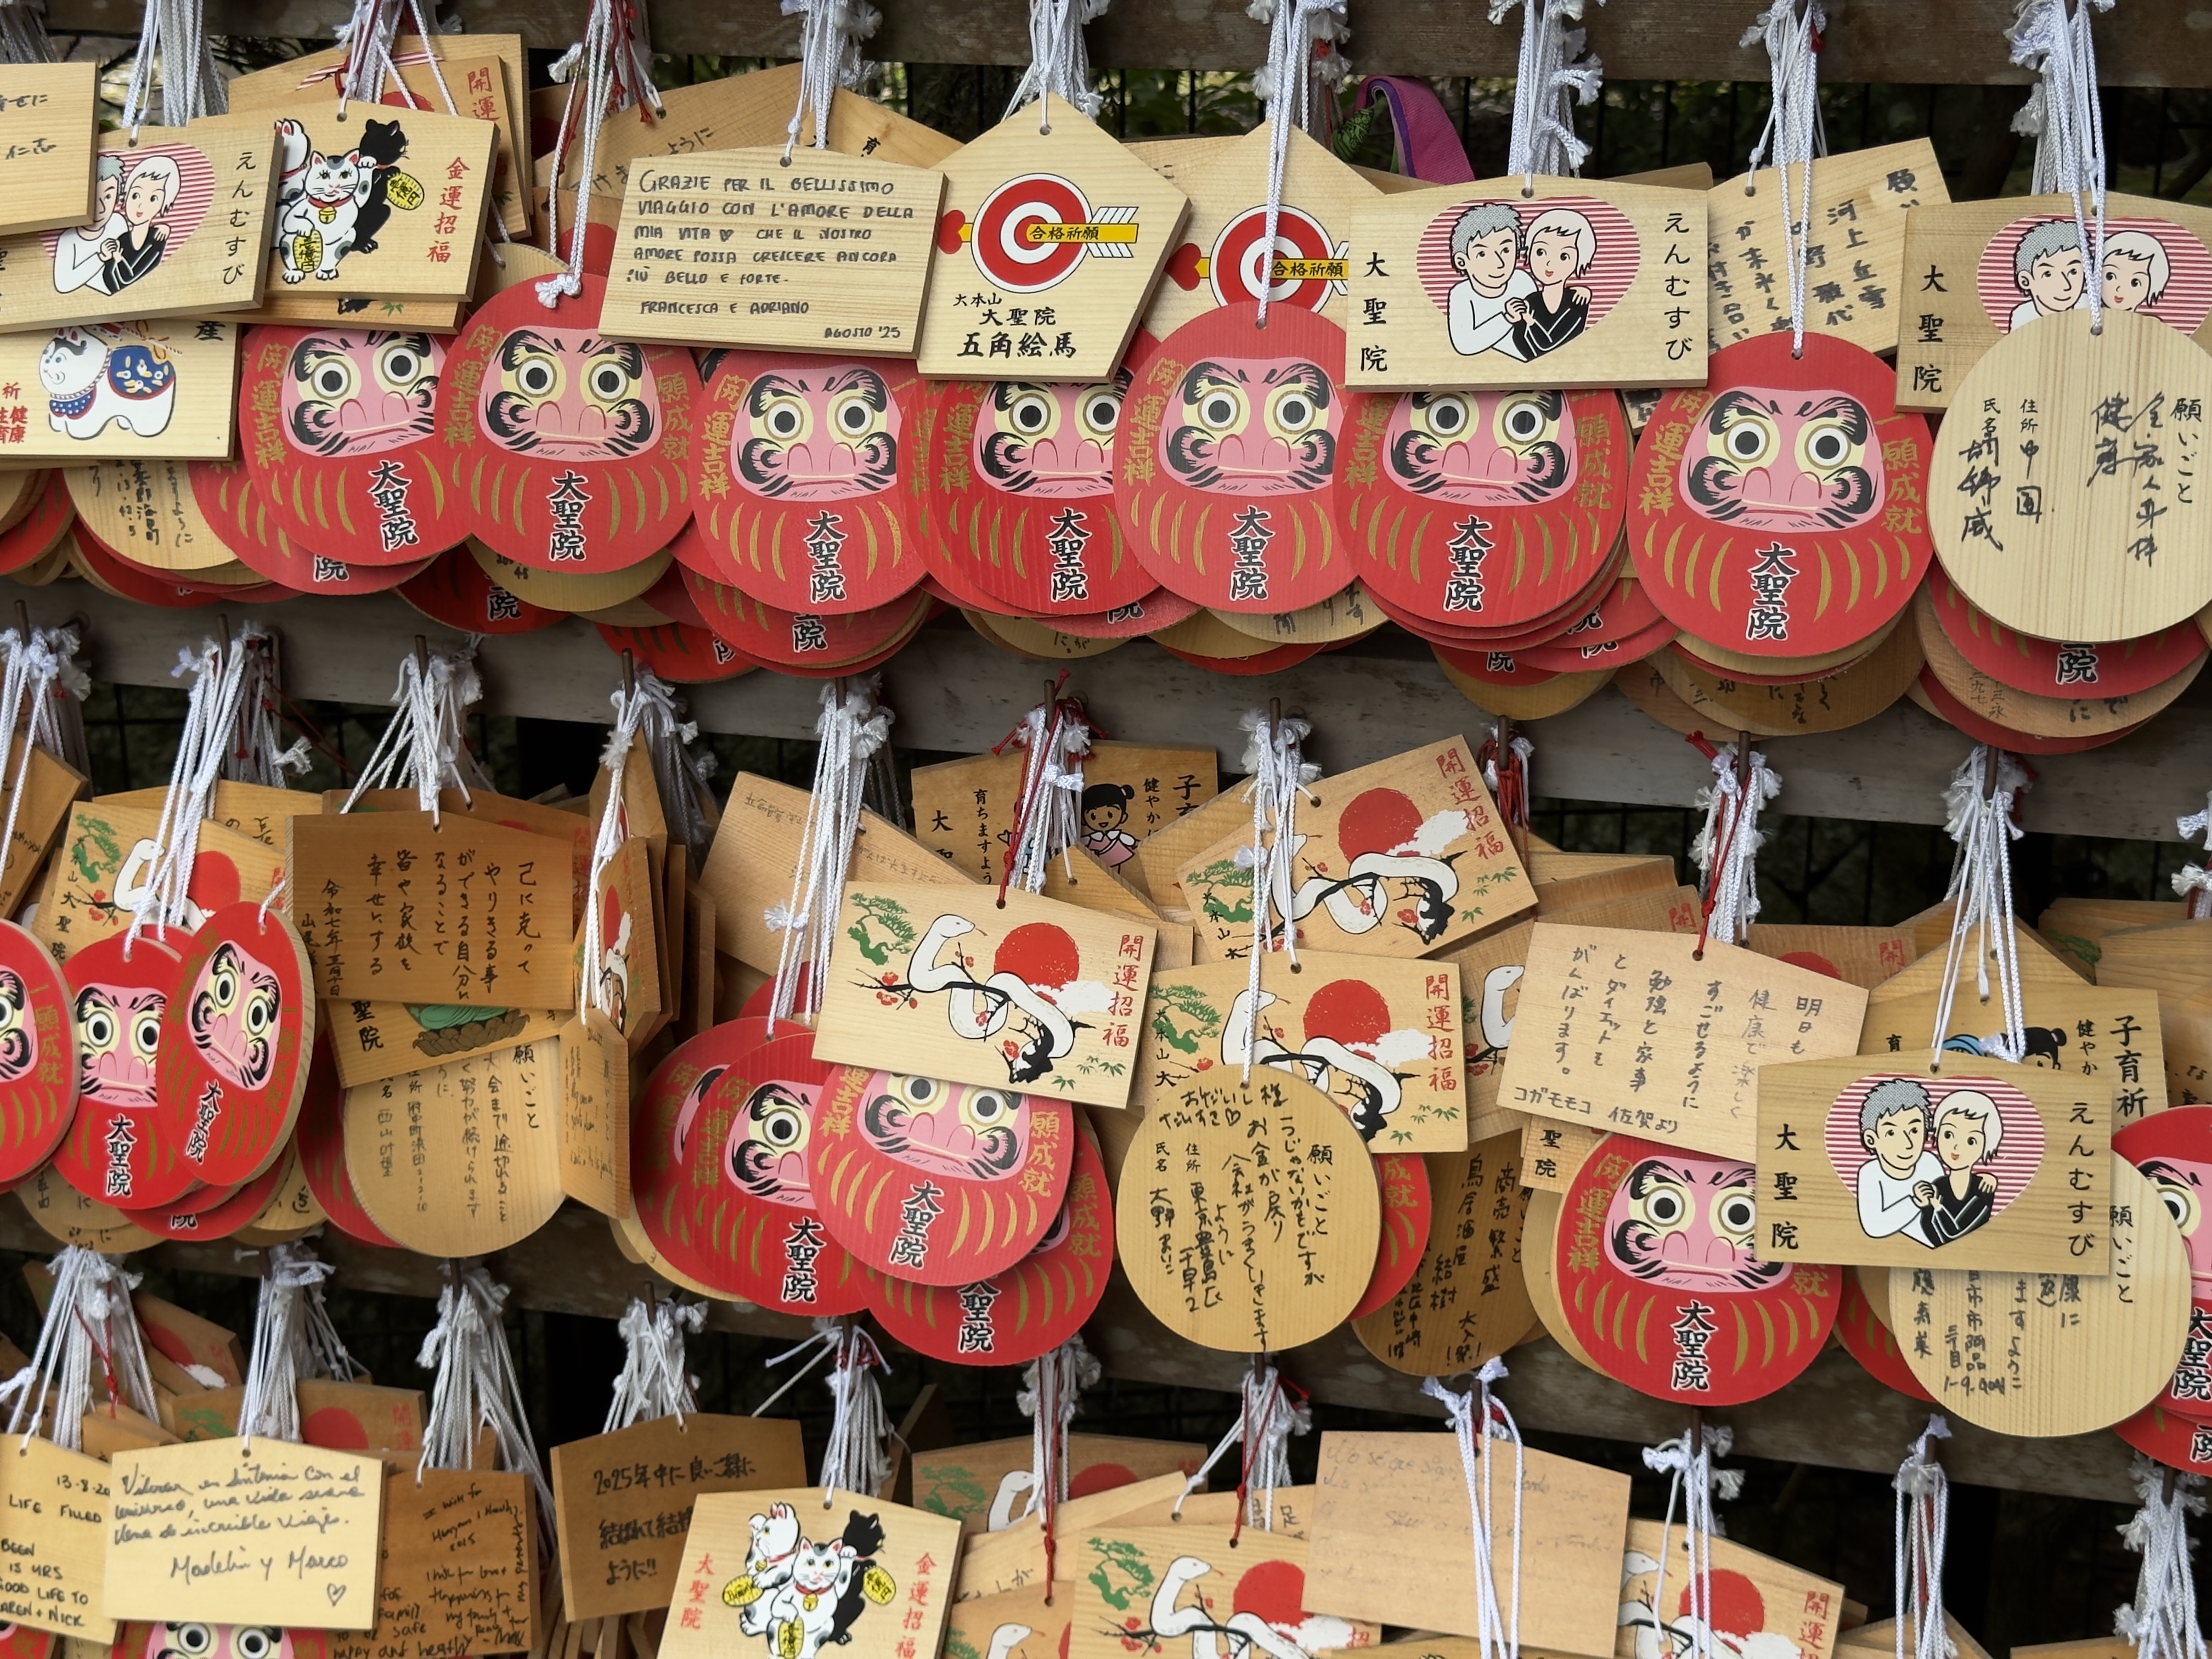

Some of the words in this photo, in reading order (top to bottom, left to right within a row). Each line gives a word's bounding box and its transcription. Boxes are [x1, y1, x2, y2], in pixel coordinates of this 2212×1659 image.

[223, 151, 256, 285] えんむすび
[427, 157, 470, 264] 金運招福
[640, 169, 712, 194] GRAZIE
[724, 178, 749, 193] PER
[760, 178, 775, 192] IL
[723, 202, 755, 216] CON
[863, 206, 914, 221] DELLA
[634, 247, 684, 262] AMORE
[753, 250, 826, 264] CRESCERE
[836, 250, 898, 263] ANCORA
[635, 225, 664, 241] MIA
[679, 226, 712, 241] VITA
[756, 228, 783, 241] CHE
[793, 228, 804, 241] IL
[665, 270, 709, 285] BELLO
[720, 272, 729, 285] E
[1029, 225, 1099, 241] 合格祈願
[1272, 260, 1344, 278] 合格祈願
[640, 300, 719, 317] FRANCESCA
[730, 301, 738, 315] E
[749, 300, 810, 315] ADRIANO
[953, 292, 1002, 307] 大本山
[979, 308, 1057, 327] 大聖院
[1360, 251, 1390, 373] 大聖院
[1663, 212, 1692, 360] えんむすび
[1912, 264, 1948, 393] 大聖院
[443, 323, 506, 449] 開運吉祥
[957, 332, 1077, 359] 五角絵馬
[252, 342, 292, 469] 開運吉祥
[698, 375, 753, 501] 開運吉祥
[1122, 357, 1187, 488] 開運吉祥
[1981, 398, 2001, 439] 氏名
[2020, 398, 2039, 434] 住所
[2170, 397, 2203, 504] 願いごと
[1638, 388, 1714, 517] 開運吉祥
[1874, 410, 1923, 535] 一願成就
[369, 461, 419, 551] 大聖院
[546, 470, 593, 562] 大聖院
[805, 511, 848, 603] 大聖院
[1046, 507, 1093, 604] 大聖院
[1227, 505, 1276, 602] 大聖院
[1445, 515, 1496, 613] 大聖院
[1745, 541, 1799, 641] 大聖院
[1436, 747, 1505, 860] 開運招福
[1102, 933, 1145, 1049] 開運招福
[1425, 973, 1459, 1092] 開運招福
[1790, 996, 1824, 1056] 明日も
[184, 1079, 224, 1165] 大聖院
[512, 1043, 540, 1130] 願いごと
[104, 1113, 138, 1198] 大聖院
[1154, 1141, 1171, 1172] 氏名
[1185, 1142, 1201, 1174] 住所
[1306, 1144, 1334, 1235] 願いごと
[1771, 1124, 1801, 1251] 大聖院
[2067, 1101, 2095, 1257] えんむすび
[888, 1181, 946, 1271] 大聖院
[1567, 1152, 1634, 1275] 開運吉祥
[782, 1217, 827, 1305] 大聖院
[1670, 1299, 1719, 1392] 大聖院
[1, 1538, 35, 1557] BEEN
[9, 1493, 42, 1514] LIFE
[60, 1504, 103, 1523] FILLED
[37, 1587, 65, 1603] LIFE
[71, 1591, 89, 1606] TO
[48, 1604, 86, 1627] NICK
[680, 1552, 715, 1630] 大聖院
